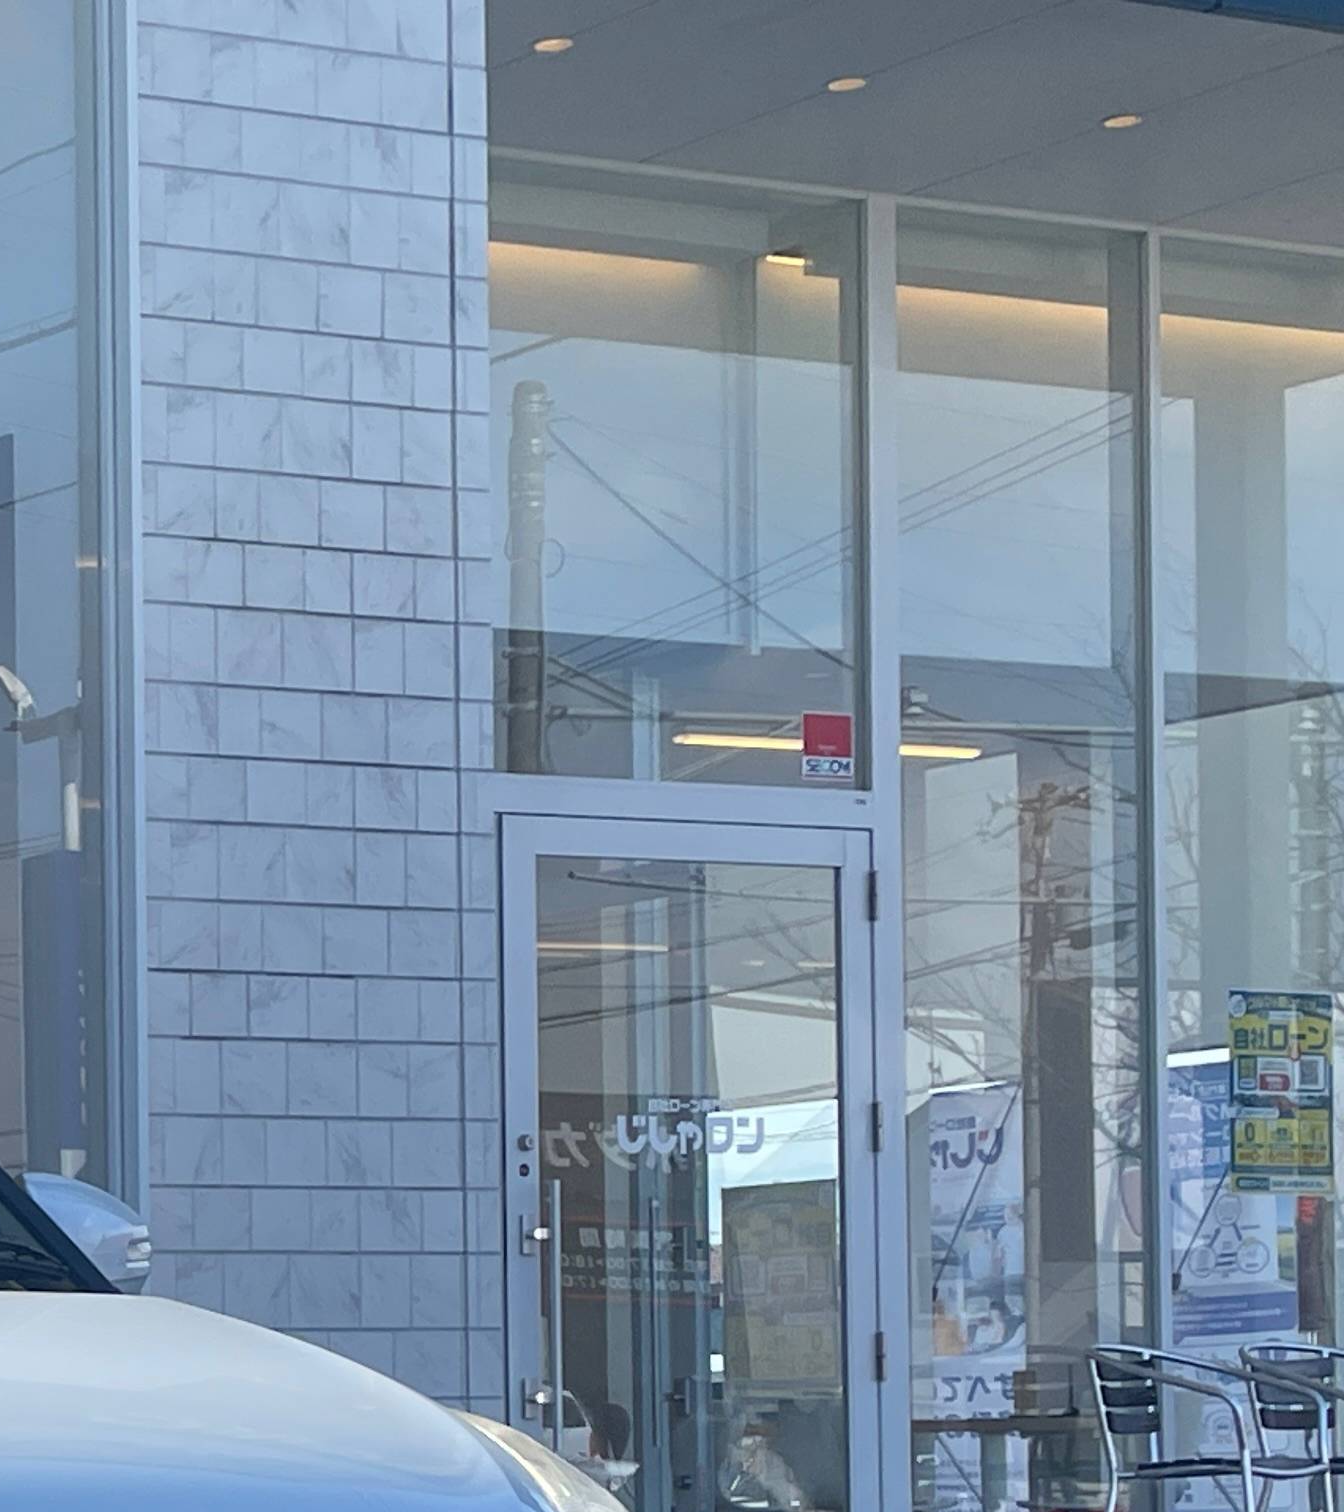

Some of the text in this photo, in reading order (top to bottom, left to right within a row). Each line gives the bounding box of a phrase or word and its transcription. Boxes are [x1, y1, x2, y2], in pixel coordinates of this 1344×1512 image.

[1233, 1024, 1329, 1050] 自社ローン
[616, 1114, 765, 1155] じしゃロン
